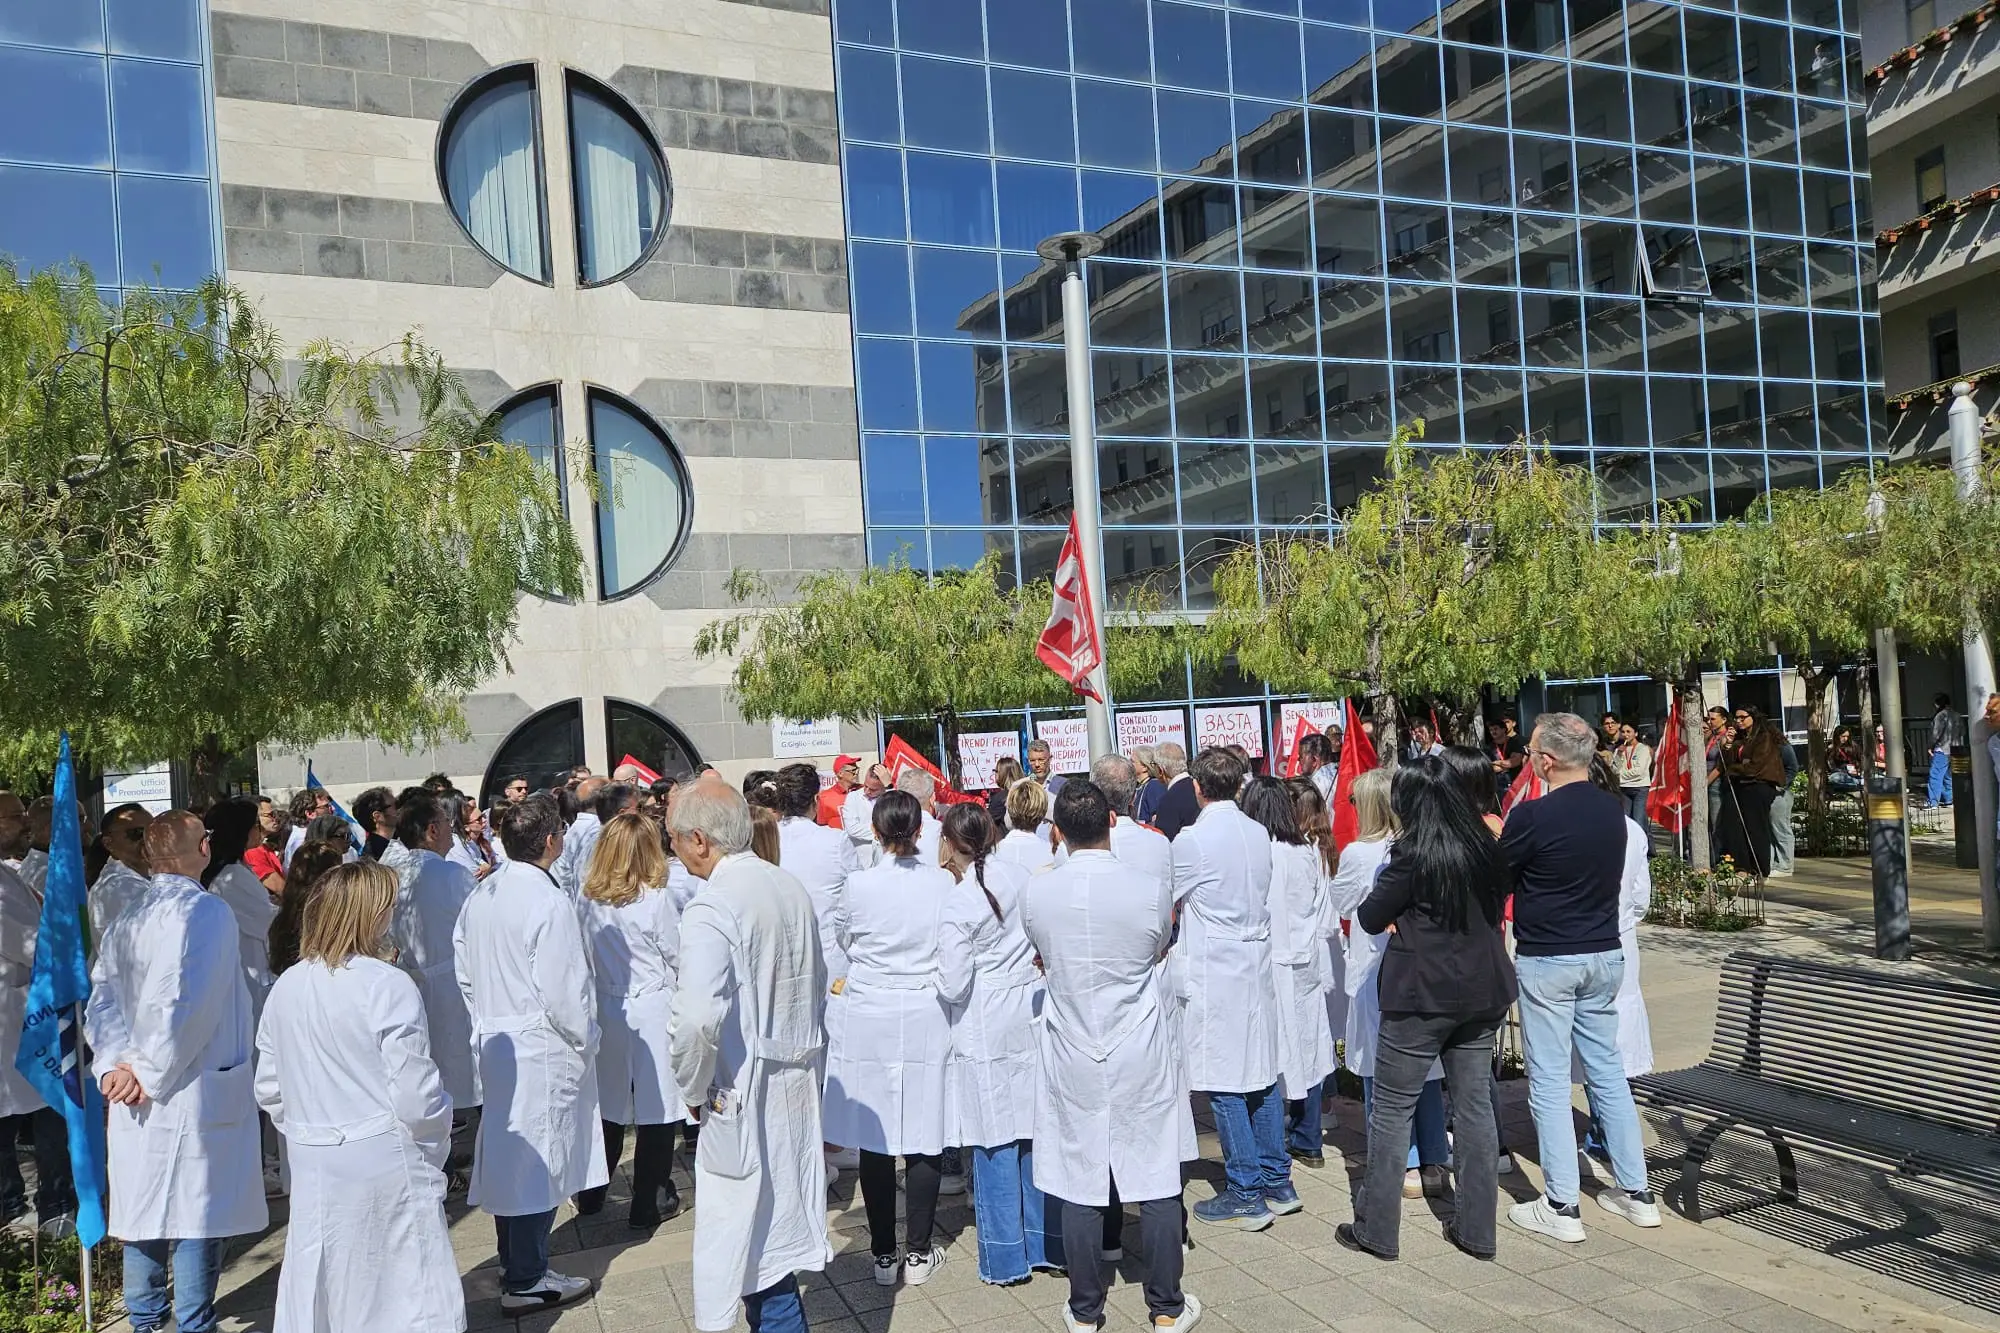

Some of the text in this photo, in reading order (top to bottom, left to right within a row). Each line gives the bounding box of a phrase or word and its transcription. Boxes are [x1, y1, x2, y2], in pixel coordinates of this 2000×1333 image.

[1119, 715, 1158, 726] CONTRATTO
[1204, 712, 1252, 732] BASTA
[1041, 725, 1059, 735] NON
[1120, 723, 1183, 735] SCADUTO DA ANNI
[992, 735, 1017, 747] FERMI
[1121, 735, 1157, 746] STIPENDI
[962, 756, 979, 767] DICI
[140, 779, 166, 787] Ufficio
[118, 785, 167, 797] Prenotazioni
